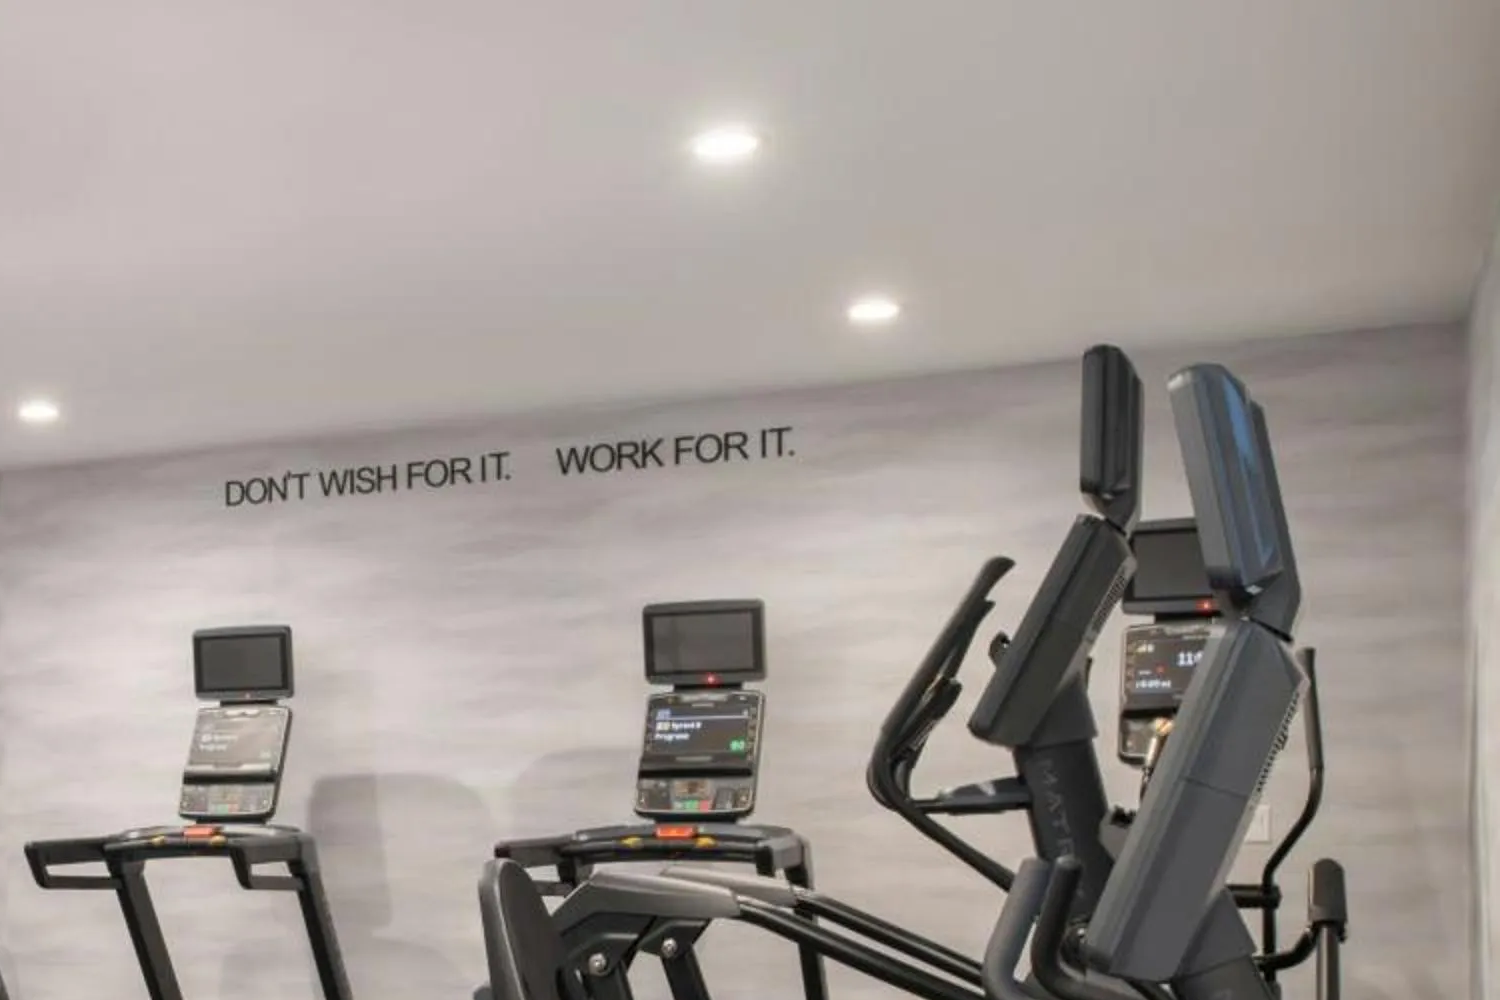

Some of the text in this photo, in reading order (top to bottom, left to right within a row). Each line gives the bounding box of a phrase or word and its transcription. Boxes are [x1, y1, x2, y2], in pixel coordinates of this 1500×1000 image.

[224, 425, 796, 507] DON'T WISH FOR IT. WORK FOR IT.
